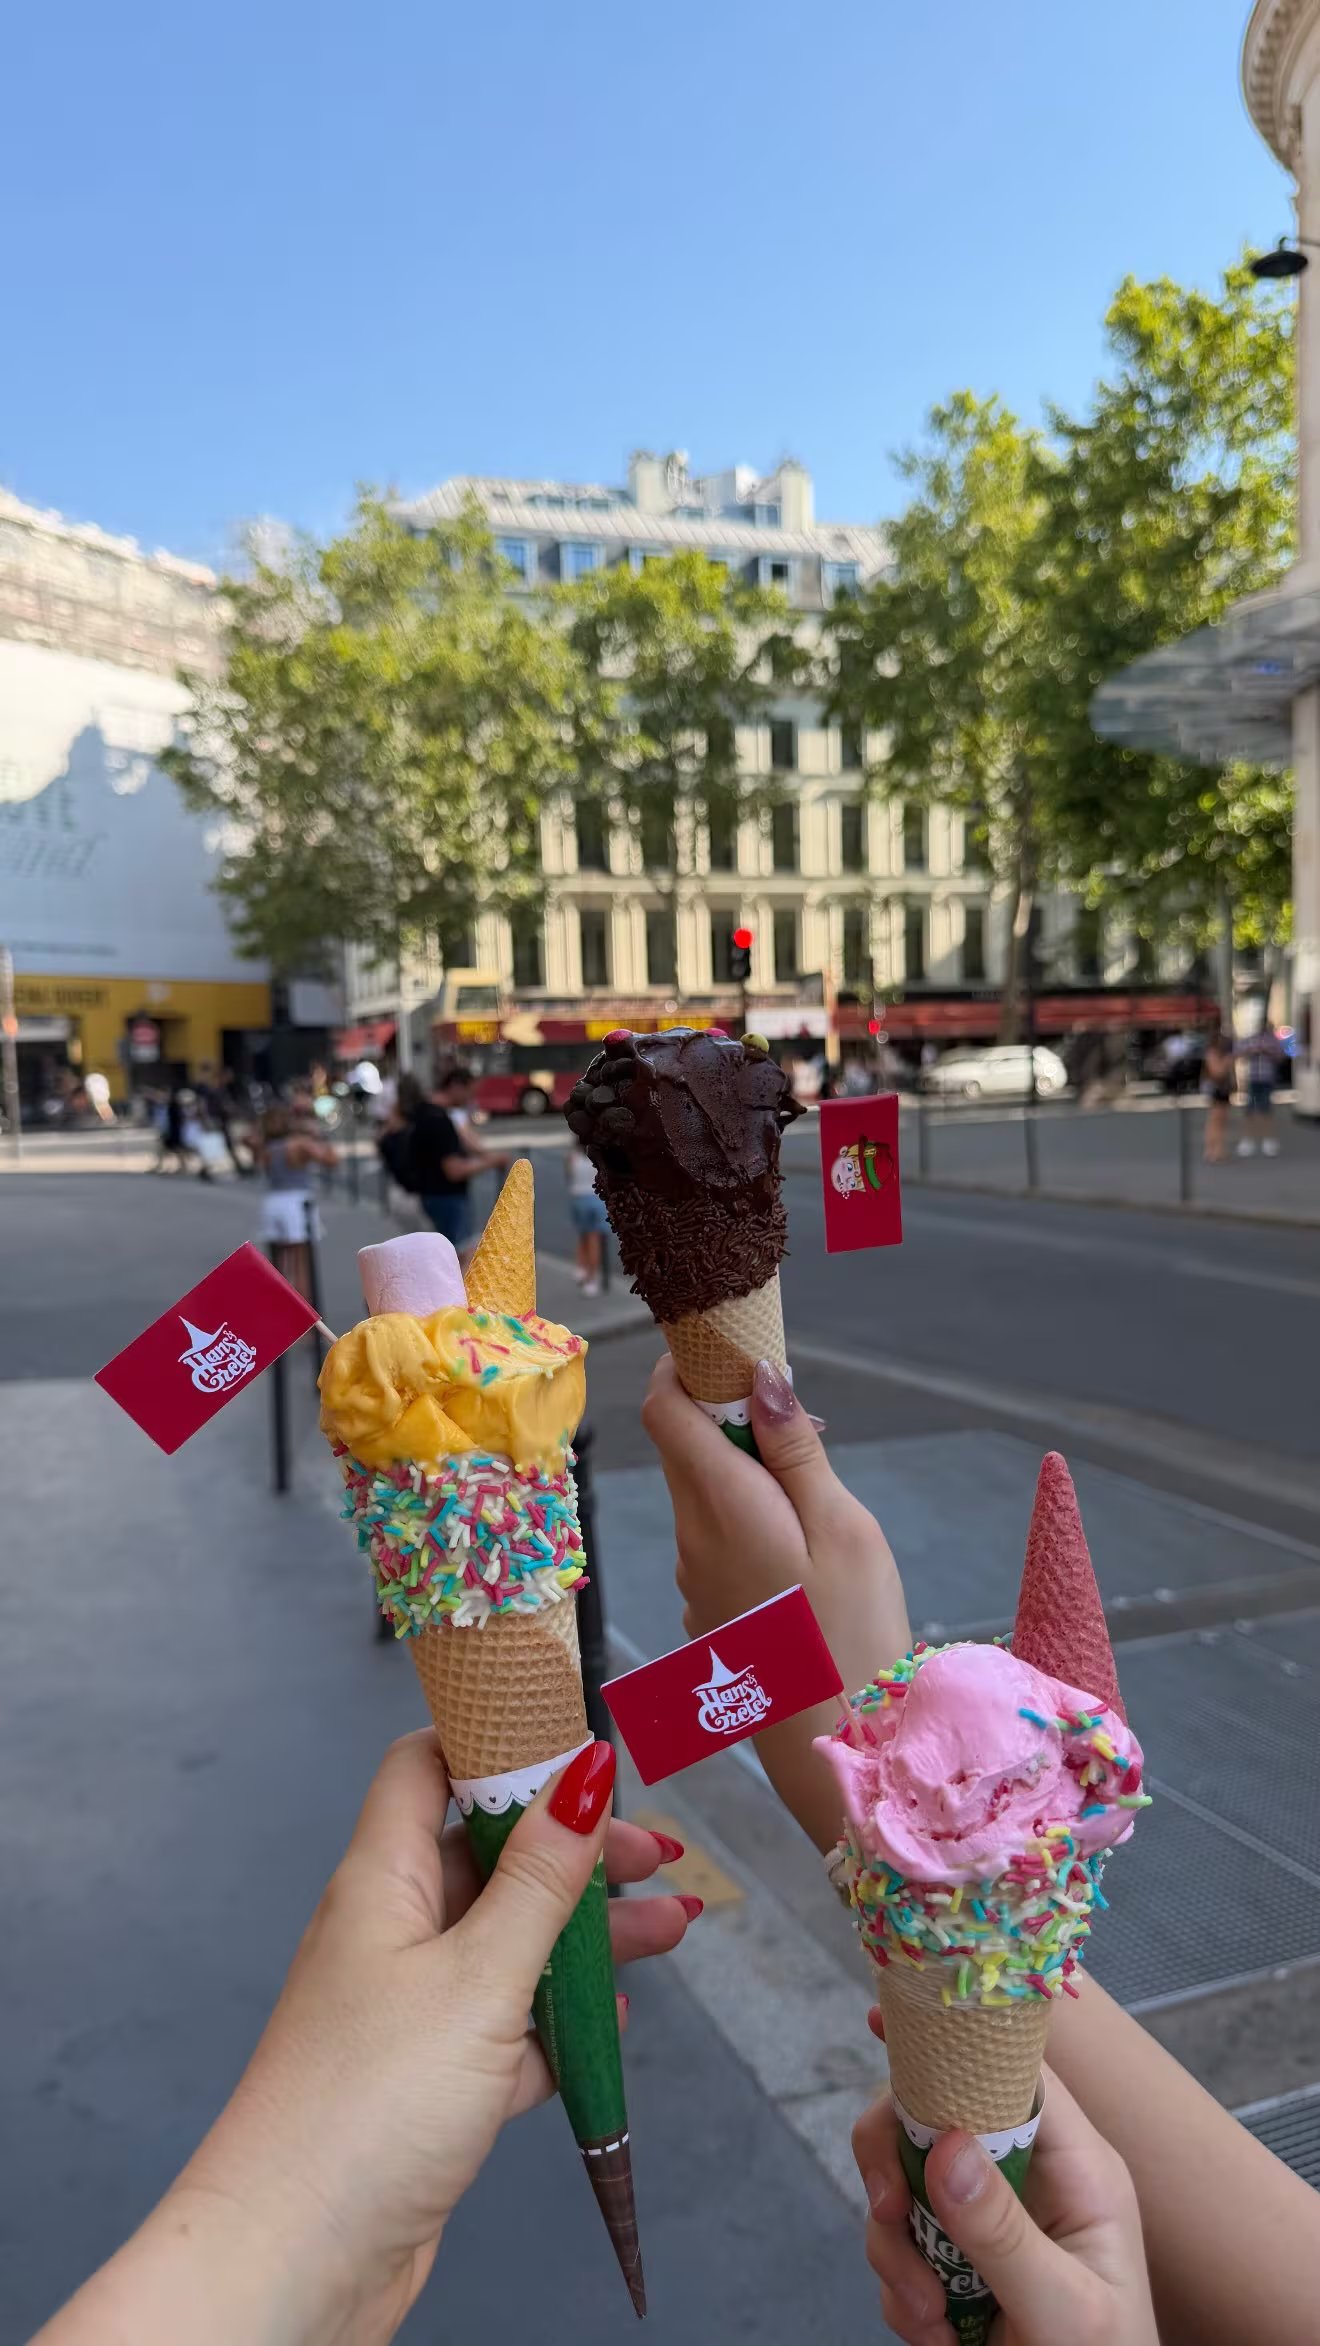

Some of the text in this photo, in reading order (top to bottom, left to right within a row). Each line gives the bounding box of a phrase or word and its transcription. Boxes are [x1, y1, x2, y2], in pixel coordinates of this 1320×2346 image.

[183, 1338, 241, 1381] Hans
[191, 1339, 257, 1393] Gretel
[696, 1680, 757, 1719] Hans
[698, 1685, 773, 1733] Gretel
[909, 2201, 968, 2264] Ha
